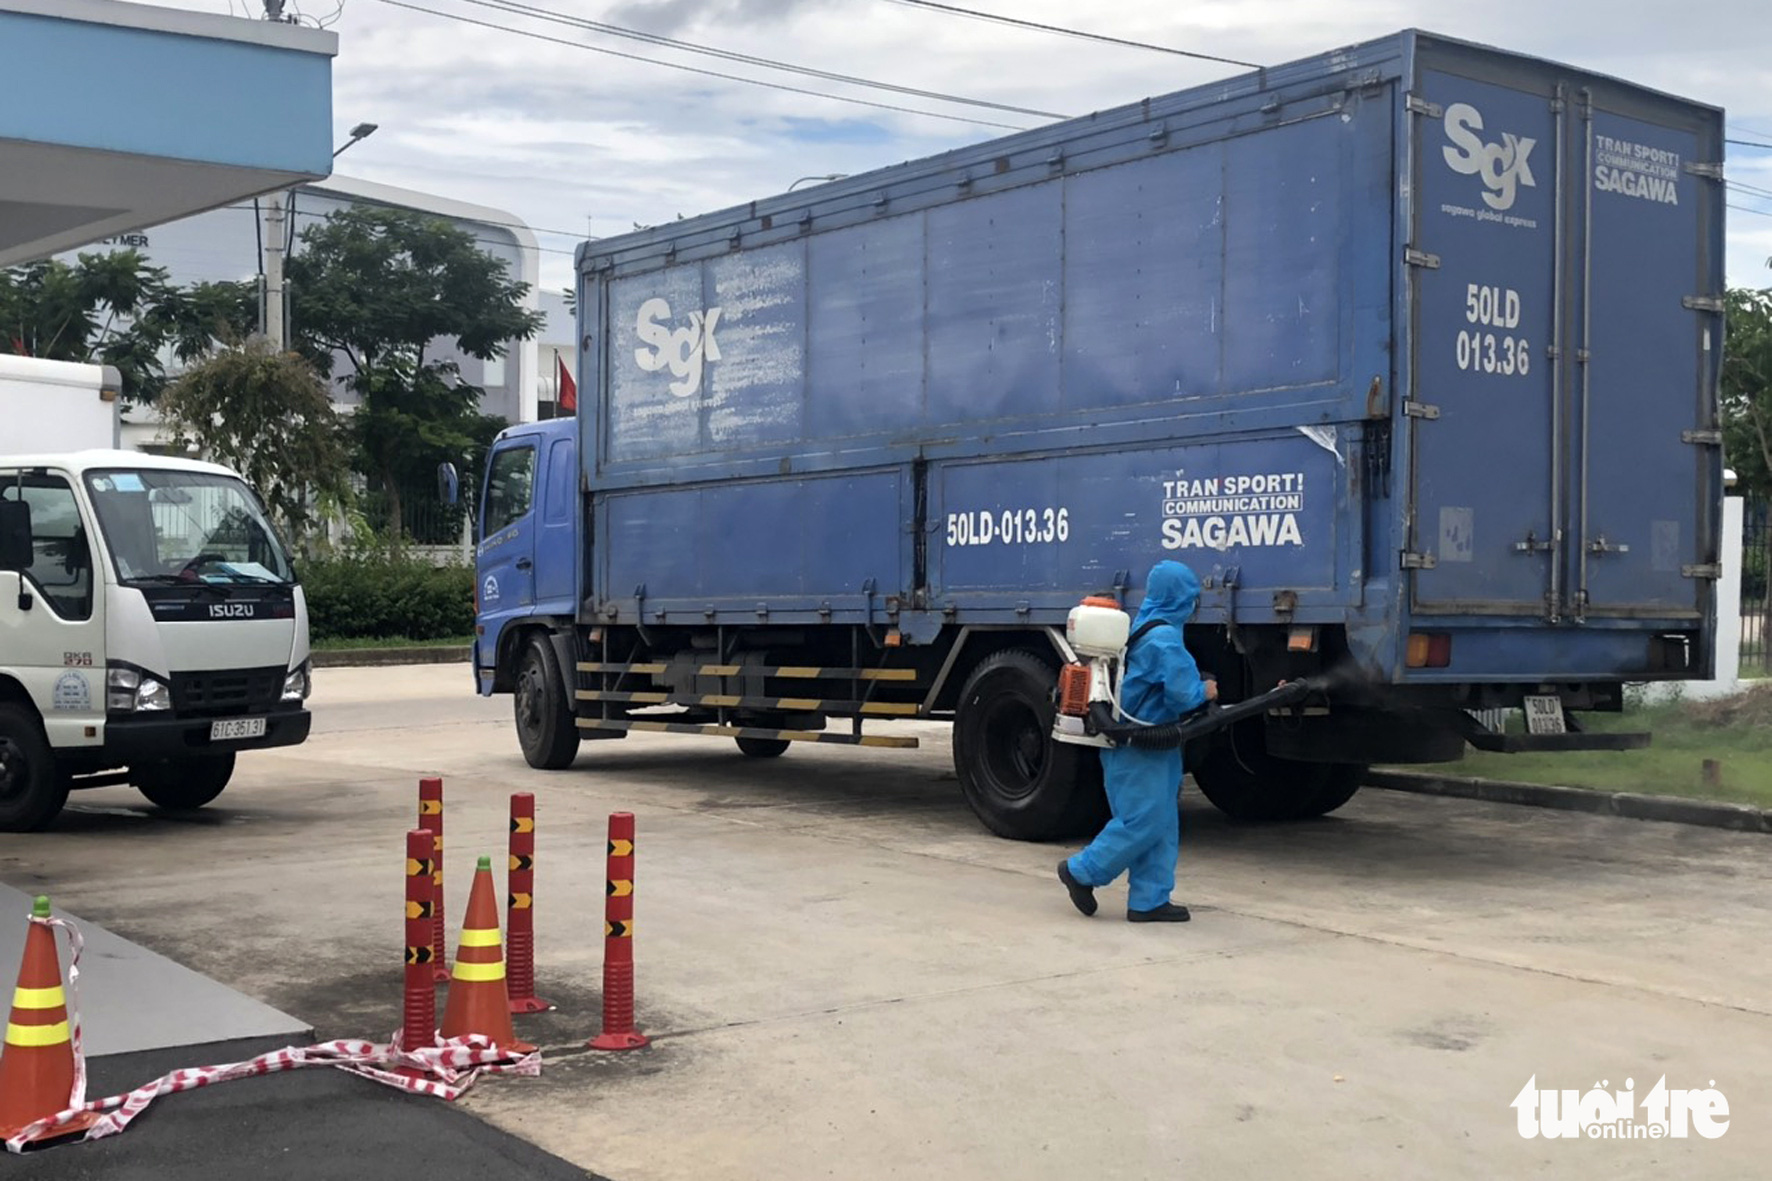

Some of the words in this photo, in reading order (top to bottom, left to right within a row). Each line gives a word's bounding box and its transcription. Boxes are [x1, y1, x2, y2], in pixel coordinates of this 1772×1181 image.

[1597, 152, 1677, 178] COMMUNICATION
[1595, 165, 1678, 205] SAGAWA
[1441, 204, 1475, 217] sagawa
[1476, 209, 1503, 222] global
[1504, 216, 1537, 228] express
[1466, 283, 1520, 328] 50LD
[1456, 330, 1529, 375] 013.36
[1224, 473, 1304, 494] SPORT!
[1164, 494, 1299, 515] COMMUNICATION
[947, 508, 1069, 546] 50LD-013.36
[1161, 513, 1303, 550] SAGAWA
[209, 604, 254, 617] ISUZU
